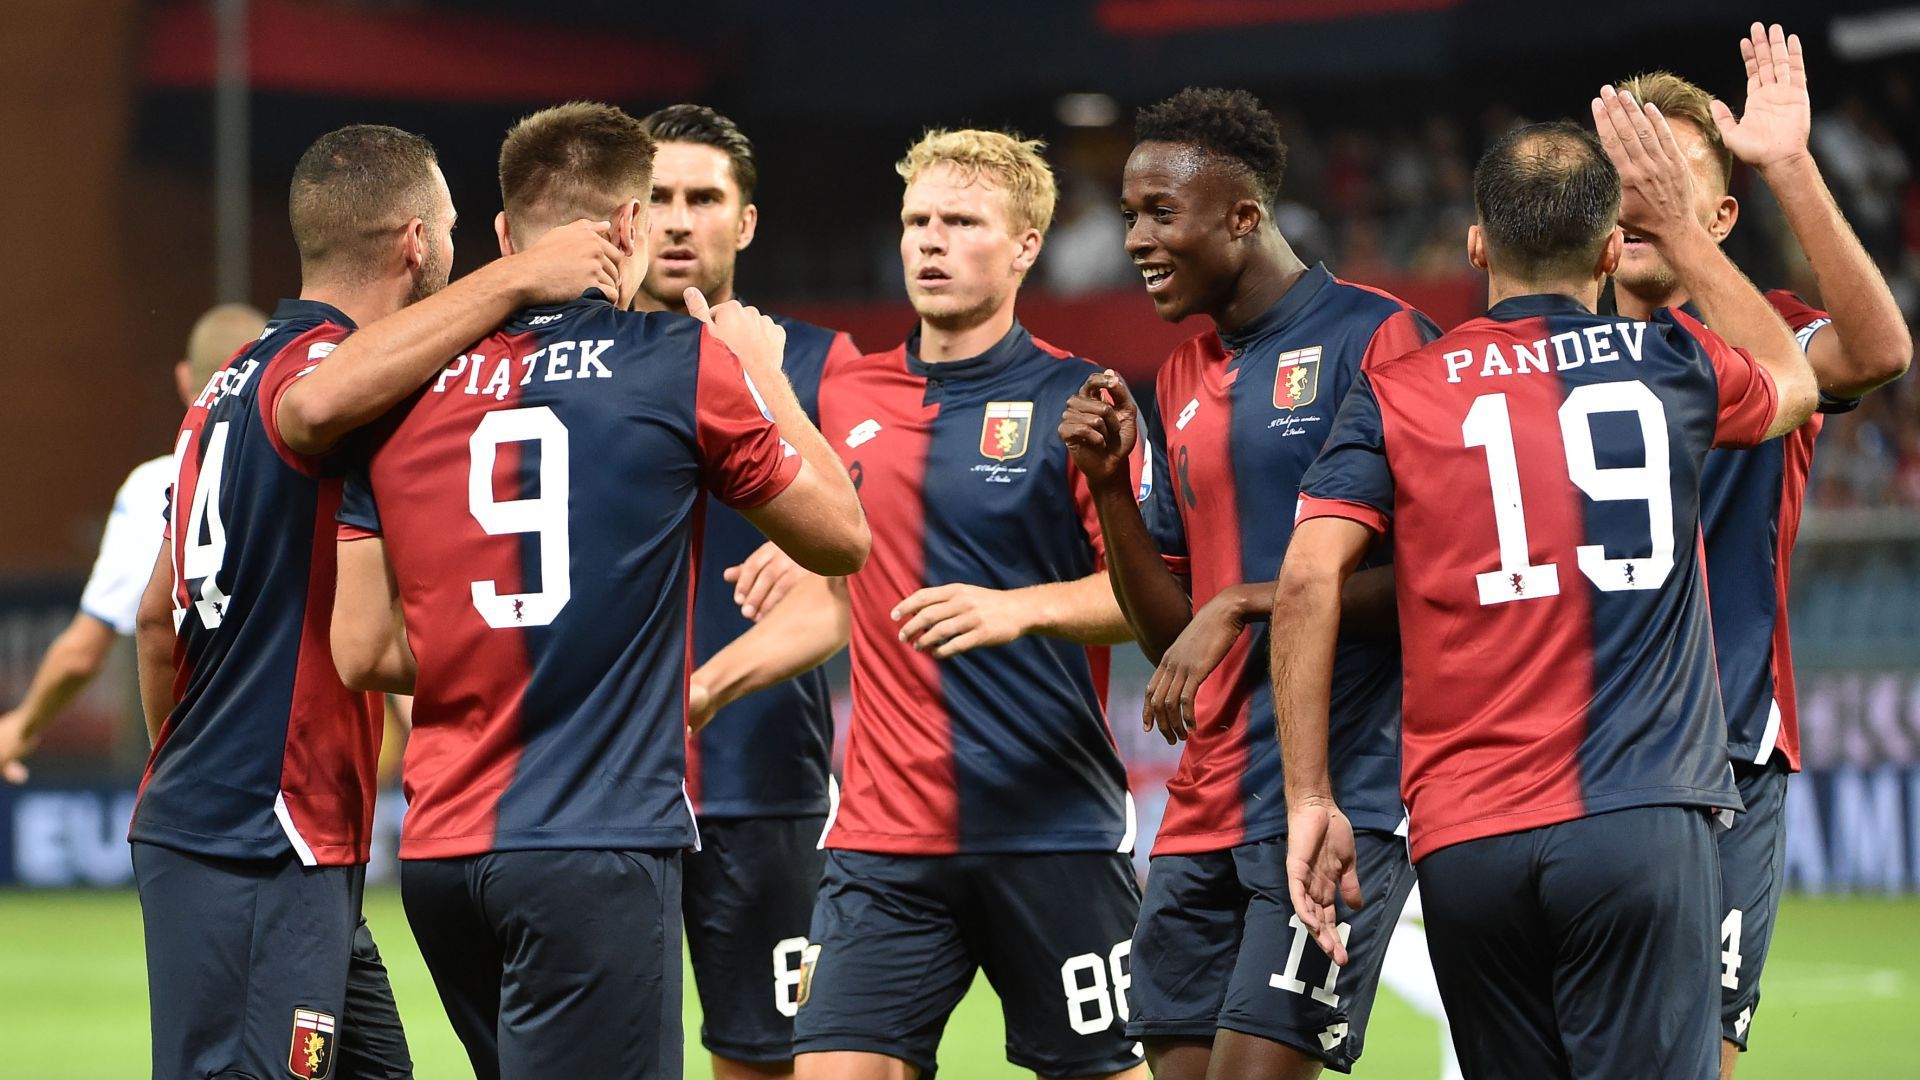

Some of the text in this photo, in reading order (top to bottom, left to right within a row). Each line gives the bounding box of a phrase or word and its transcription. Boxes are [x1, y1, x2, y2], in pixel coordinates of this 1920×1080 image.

[433, 339, 614, 400] PIĄTEK
[1443, 322, 1647, 383] PANDEV
[469, 406, 570, 628] 9
[1461, 379, 1674, 605] 19
[1268, 913, 1352, 1009] 11
[1721, 908, 1743, 990] 4
